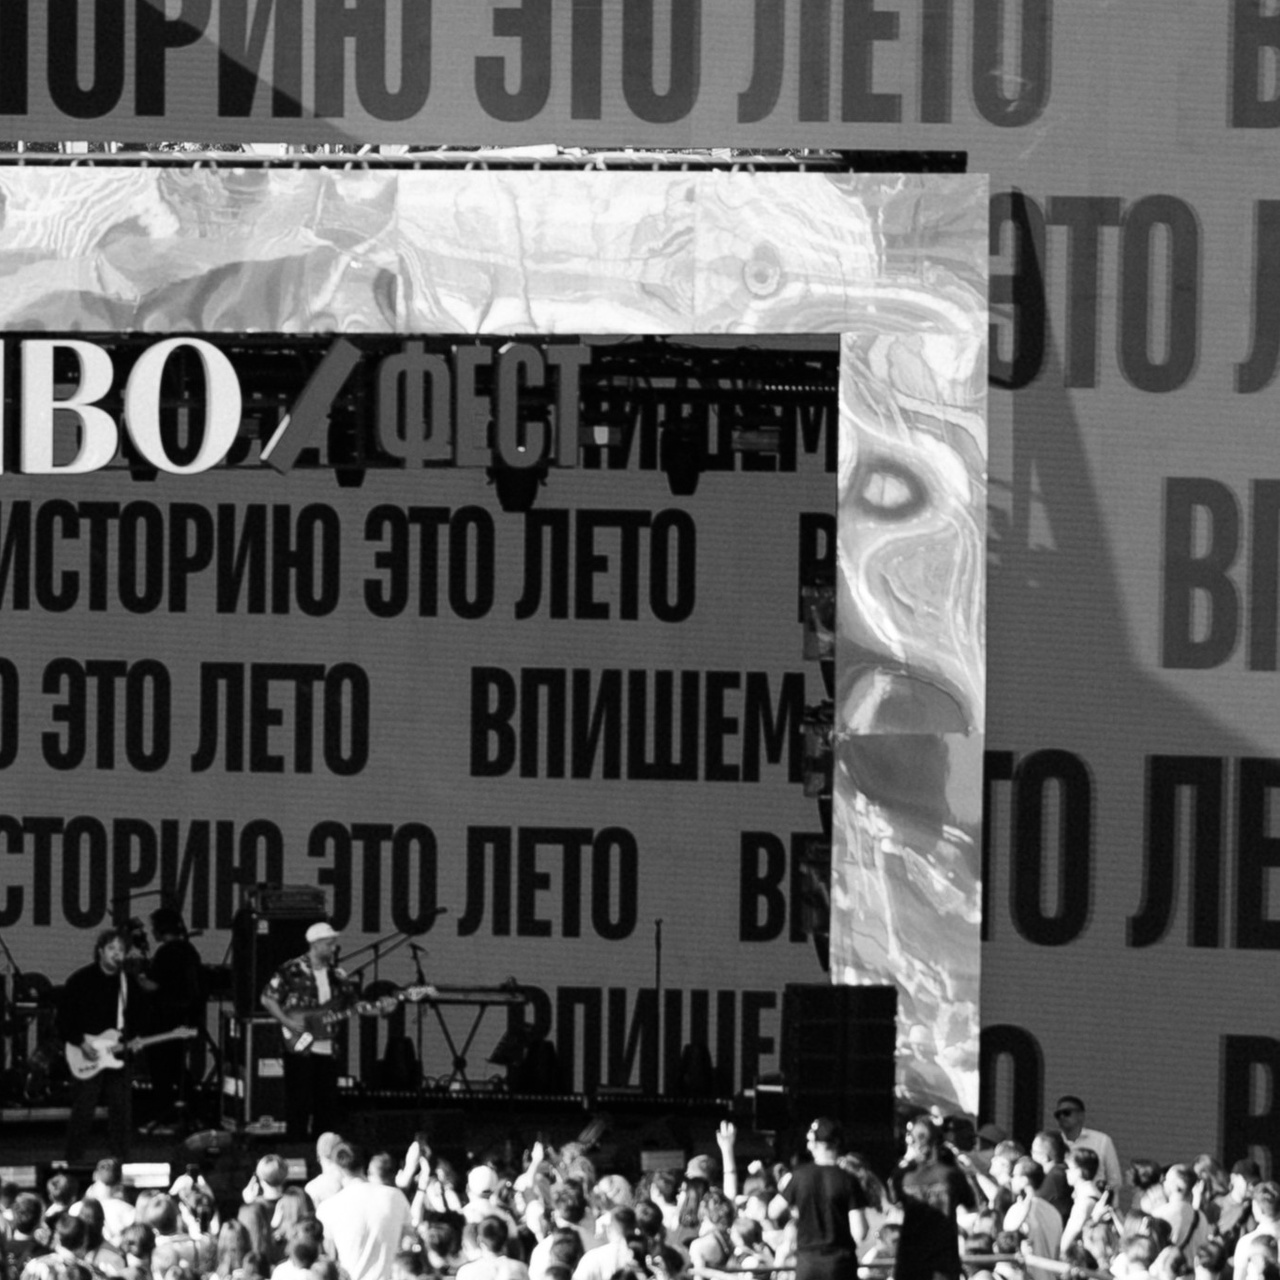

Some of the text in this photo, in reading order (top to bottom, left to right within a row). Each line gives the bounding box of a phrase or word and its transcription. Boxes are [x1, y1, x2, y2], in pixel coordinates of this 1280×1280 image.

[363, 504, 495, 620] ЭТО
[515, 508, 696, 623] ЛЕТО
[41, 658, 171, 772] ЭТО
[191, 661, 370, 777] ЛЕТО
[469, 665, 807, 784] ВПИШЕМ
[308, 822, 438, 936] ЭТО
[457, 825, 638, 941] ЛЕТО
